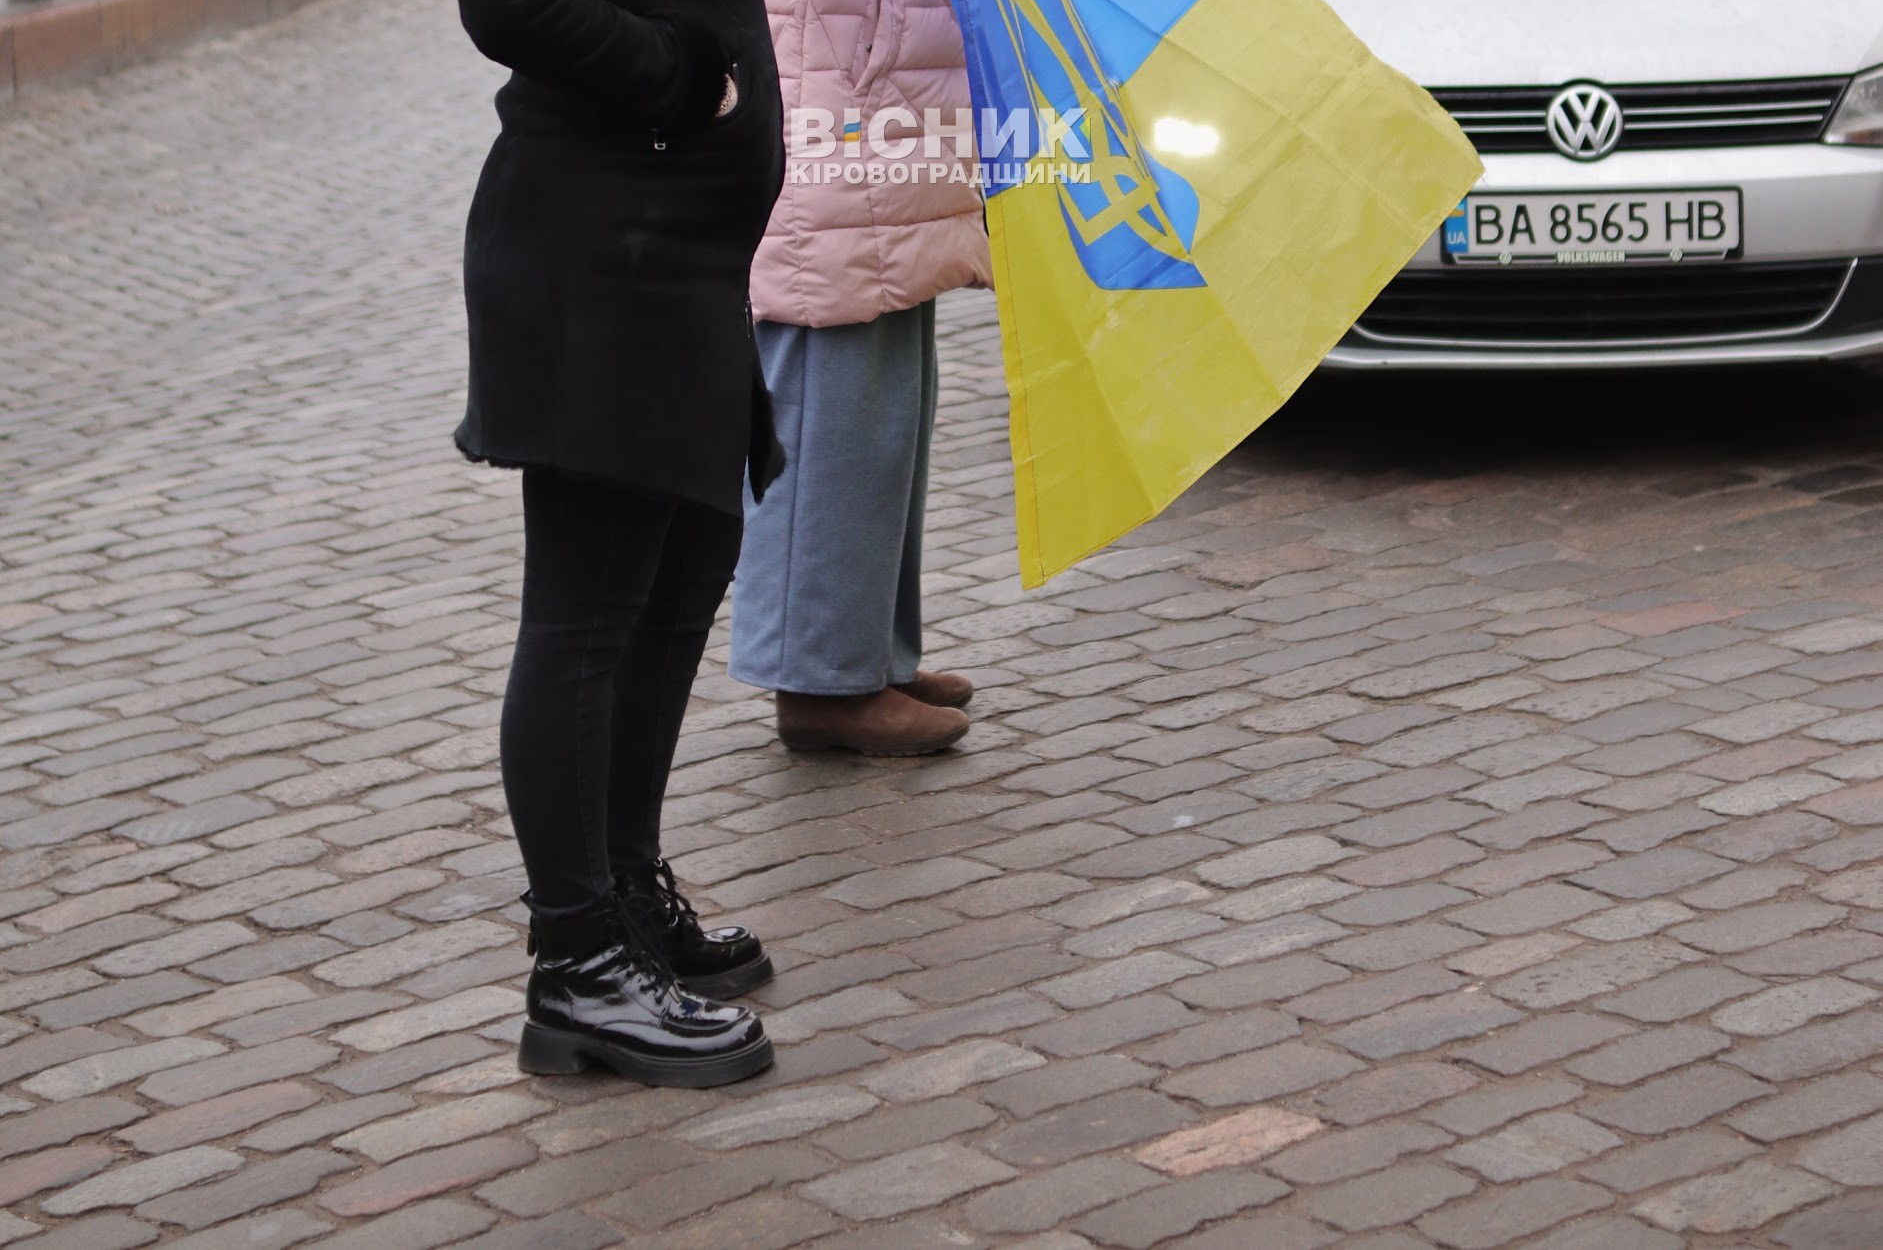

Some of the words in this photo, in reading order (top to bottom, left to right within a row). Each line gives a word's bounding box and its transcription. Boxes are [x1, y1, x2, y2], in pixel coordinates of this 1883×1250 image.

[1475, 203, 1536, 246] BA
[1550, 201, 1649, 244] 8565
[1664, 199, 1727, 242] HB
[1447, 234, 1467, 245] UA
[1556, 250, 1626, 263] VOLKSWAGEN
